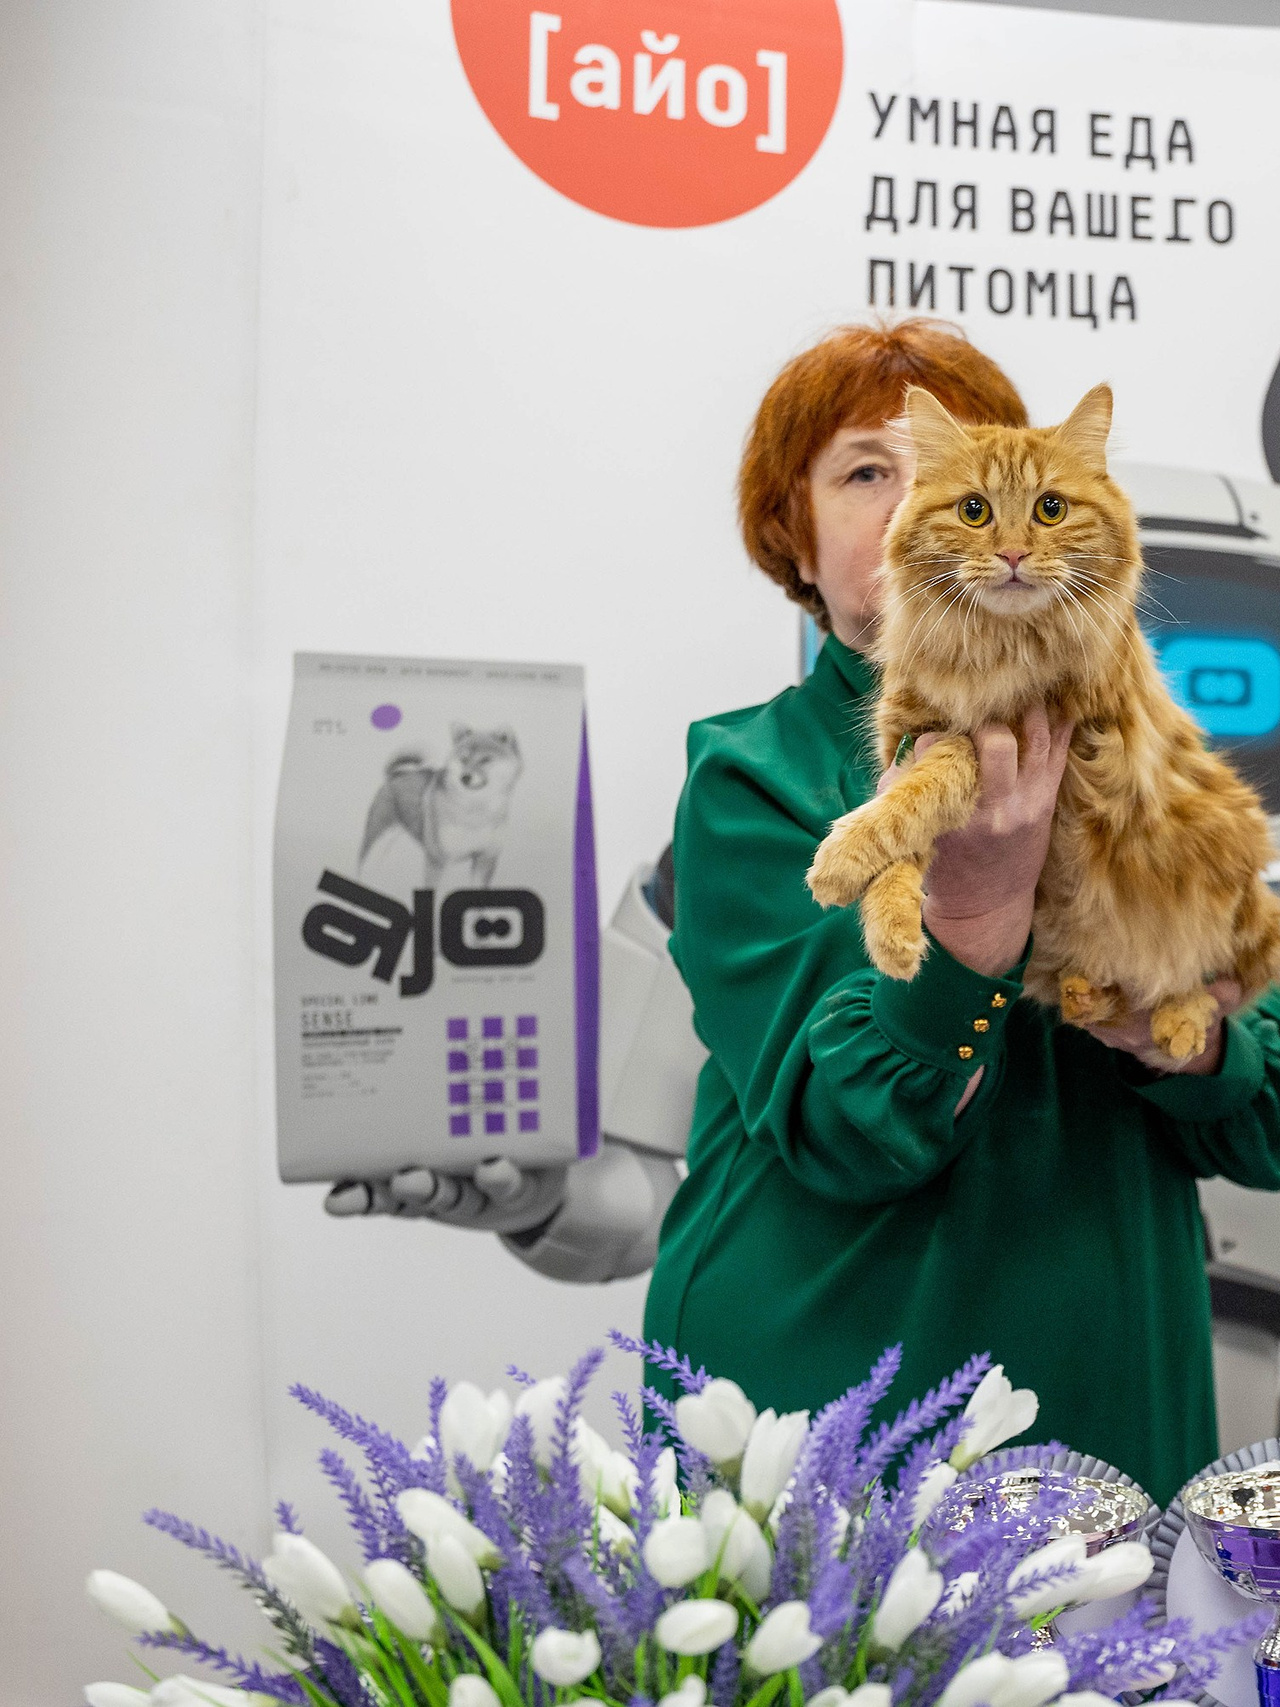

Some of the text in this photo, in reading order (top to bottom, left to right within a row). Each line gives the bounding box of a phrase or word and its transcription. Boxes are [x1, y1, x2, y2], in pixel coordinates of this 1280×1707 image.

[528, 11, 788, 154] [айо]
[869, 91, 1196, 170] УМНАЯ ЕДА
[865, 175, 1236, 245] ДЛЯ ВАШЕГО
[866, 258, 1139, 330] ПИТОМЦА
